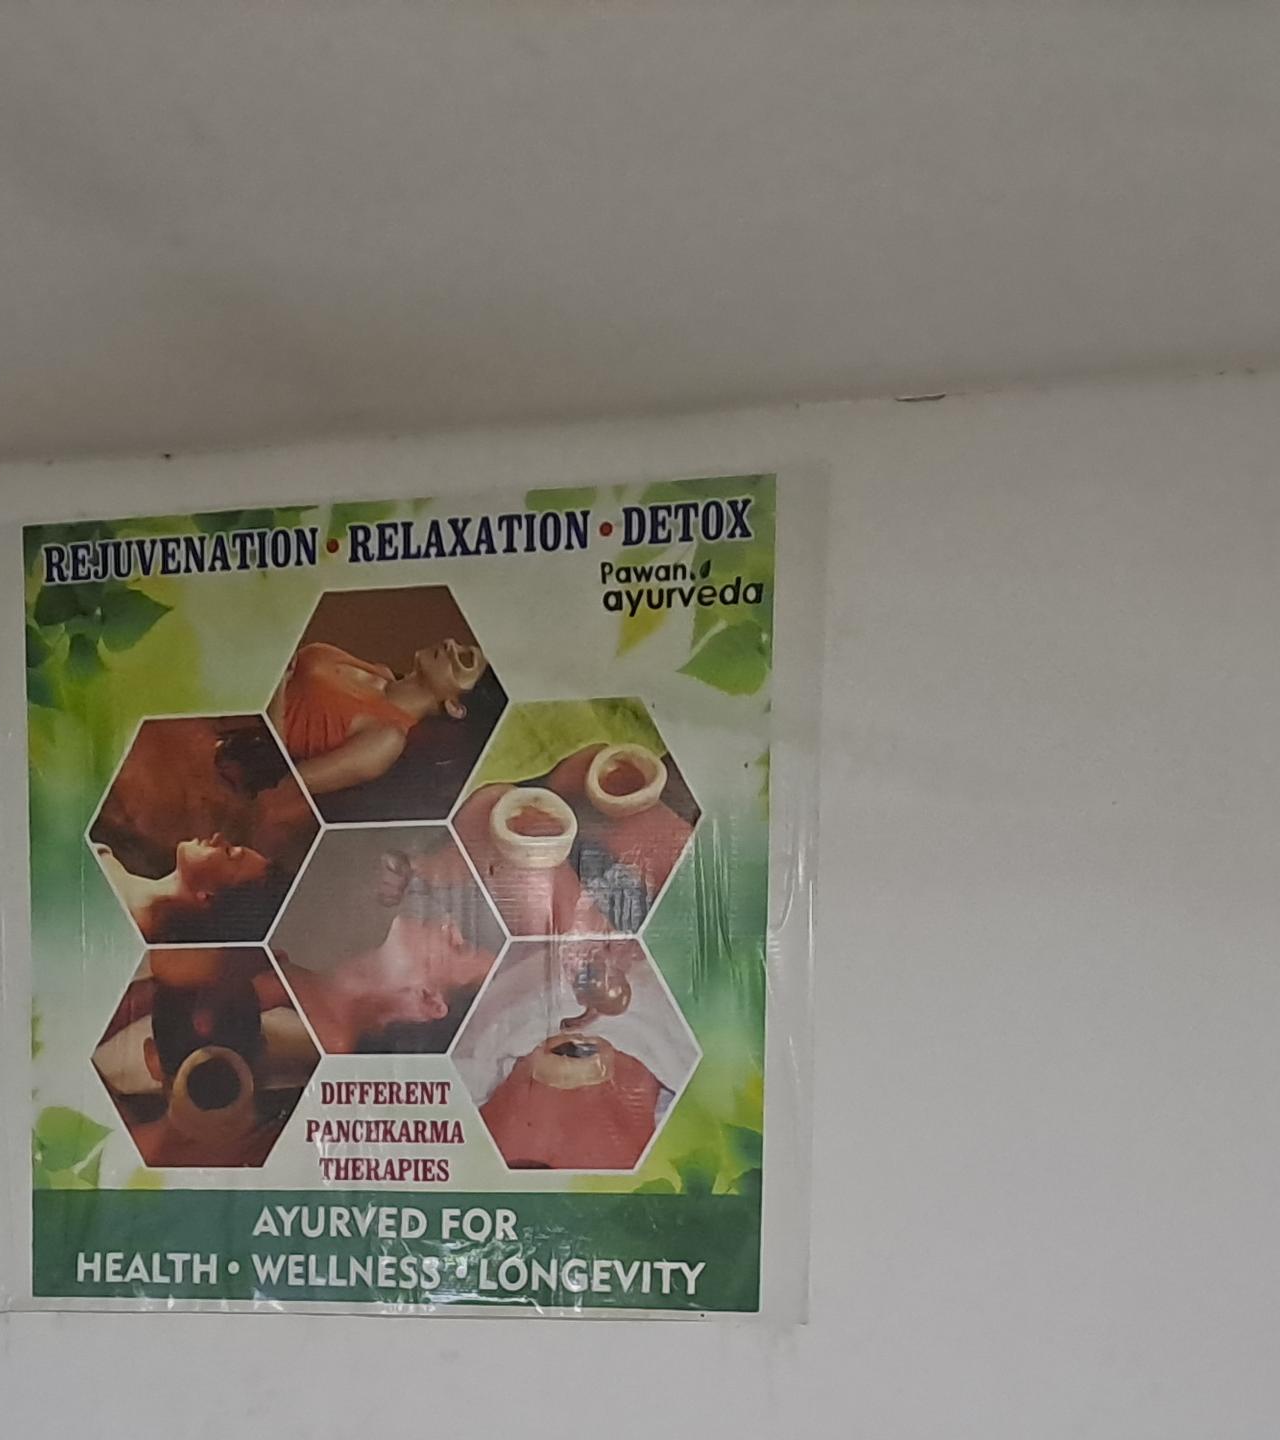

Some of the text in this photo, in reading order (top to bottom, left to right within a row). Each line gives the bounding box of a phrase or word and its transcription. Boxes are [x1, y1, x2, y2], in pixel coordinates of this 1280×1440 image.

[44, 498, 753, 583] REJUVENATION RELAXATION DETOX
[600, 560, 688, 584] Pawan
[602, 577, 765, 617] ayurveda
[320, 1081, 451, 1105] DIFFERENT
[306, 1119, 465, 1144] PANCHKARMA
[319, 1157, 450, 1182] THERAPIES
[252, 1205, 518, 1242] AYURVED FOR
[76, 1252, 706, 1295] HEALTH WELLNESS LONGEVITY
